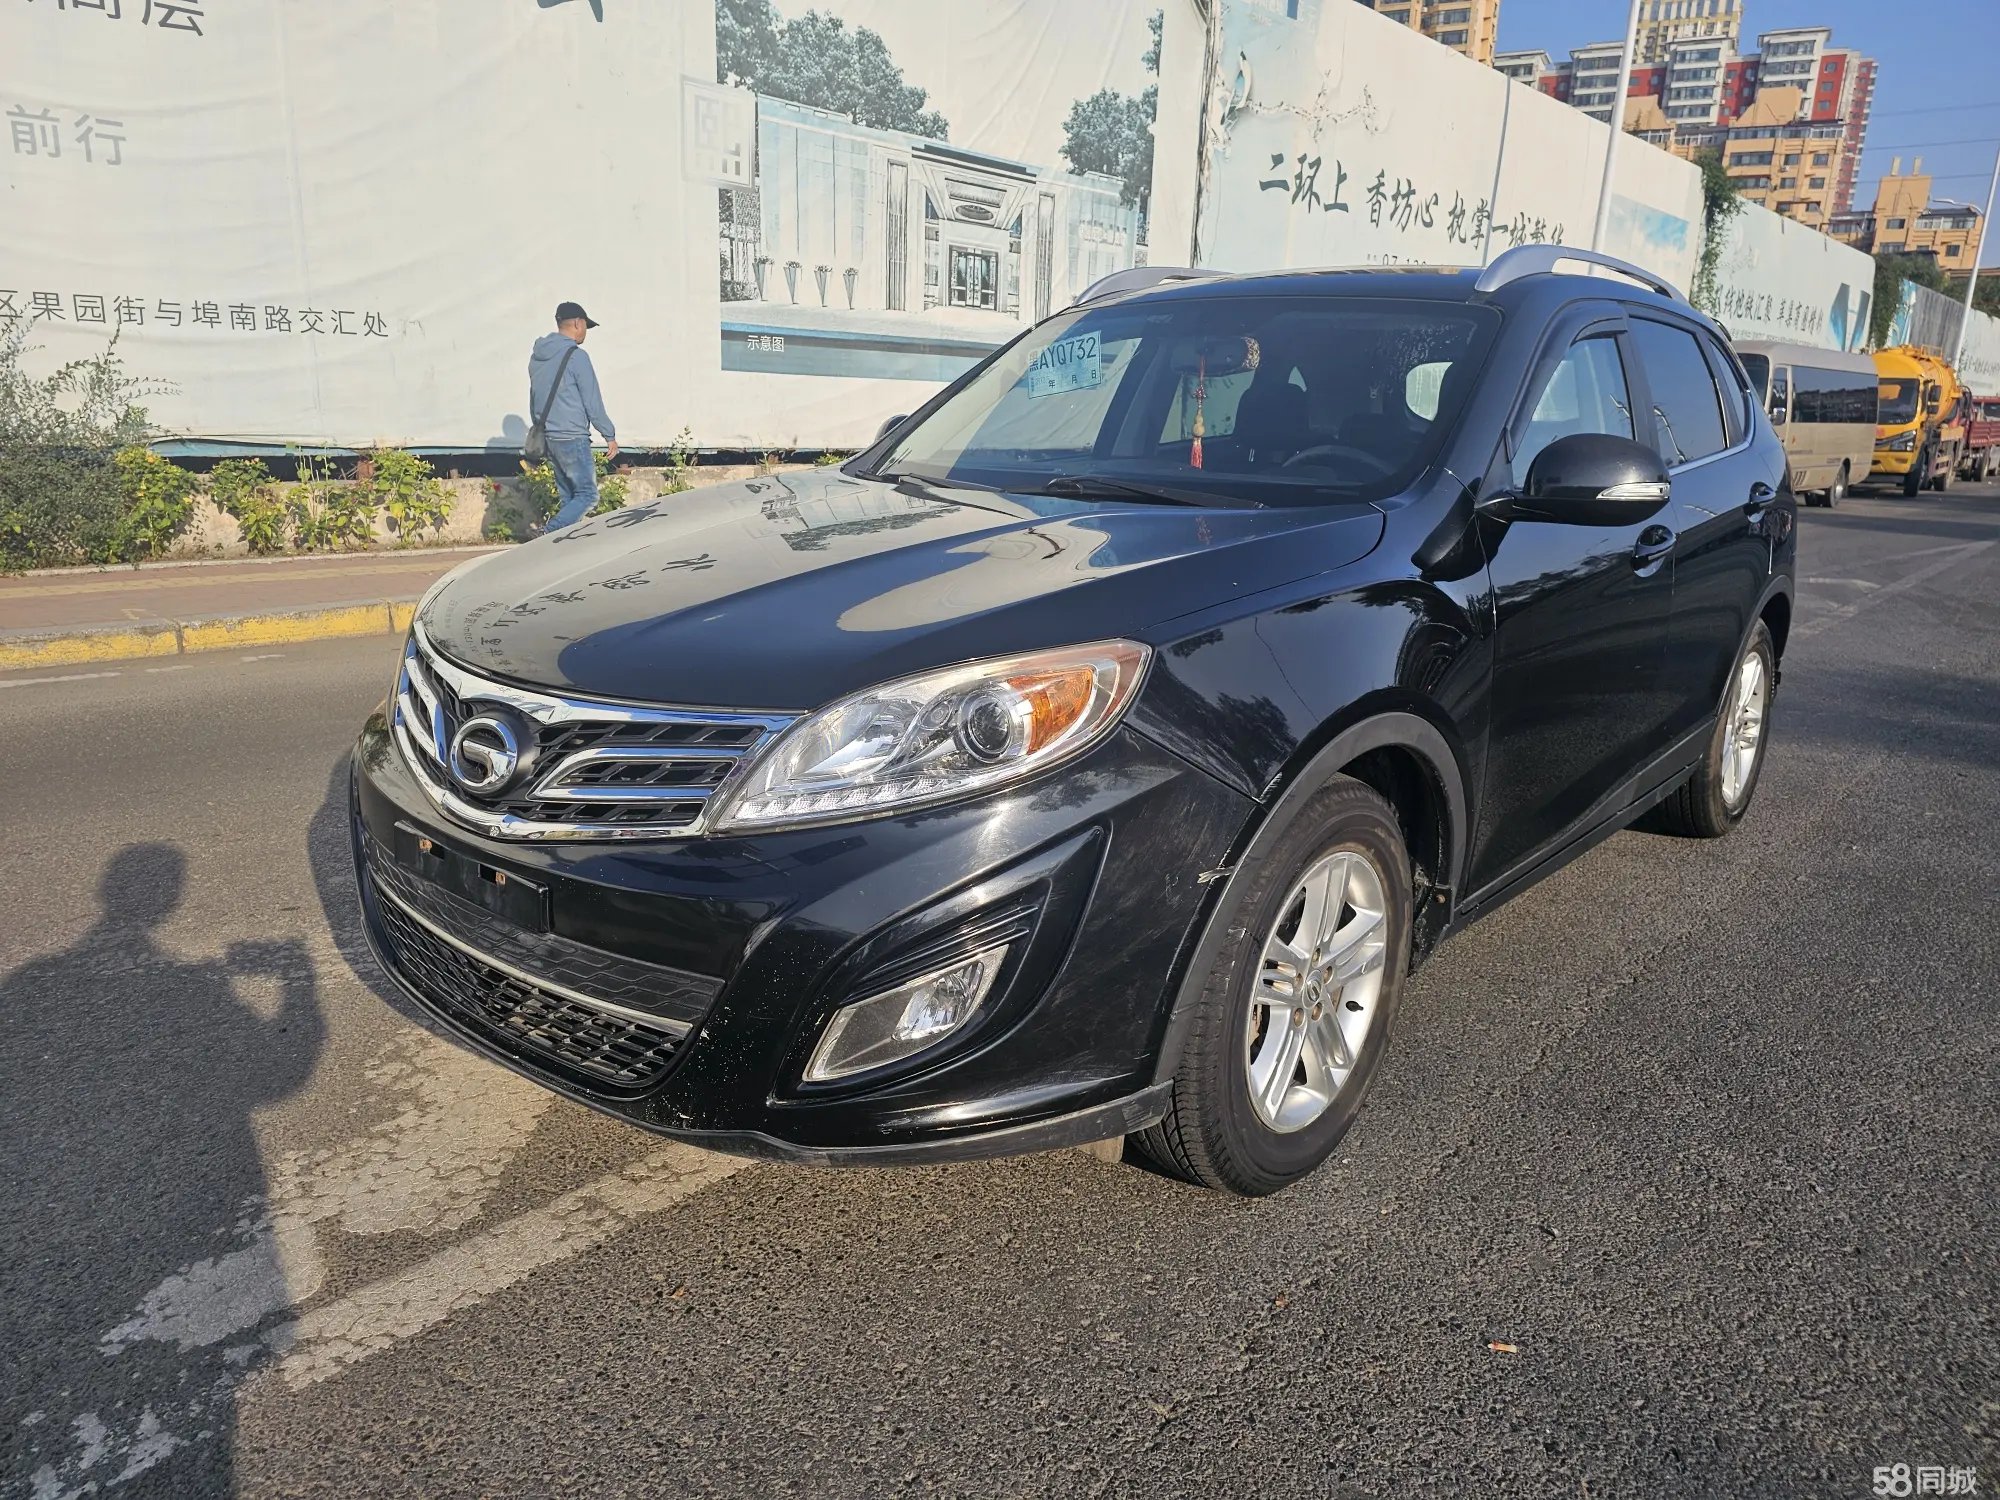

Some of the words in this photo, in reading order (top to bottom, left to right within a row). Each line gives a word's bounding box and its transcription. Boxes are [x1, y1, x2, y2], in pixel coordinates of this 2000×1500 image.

[6, 104, 127, 166] 前行
[1259, 153, 1349, 214] 二环上
[1366, 168, 1439, 233] 香坊心
[0, 289, 389, 337] 区果园街与埠南路交汇处
[747, 335, 785, 352] 示意图
[1071, 374, 1077, 384] 月
[1091, 369, 1097, 379] 日
